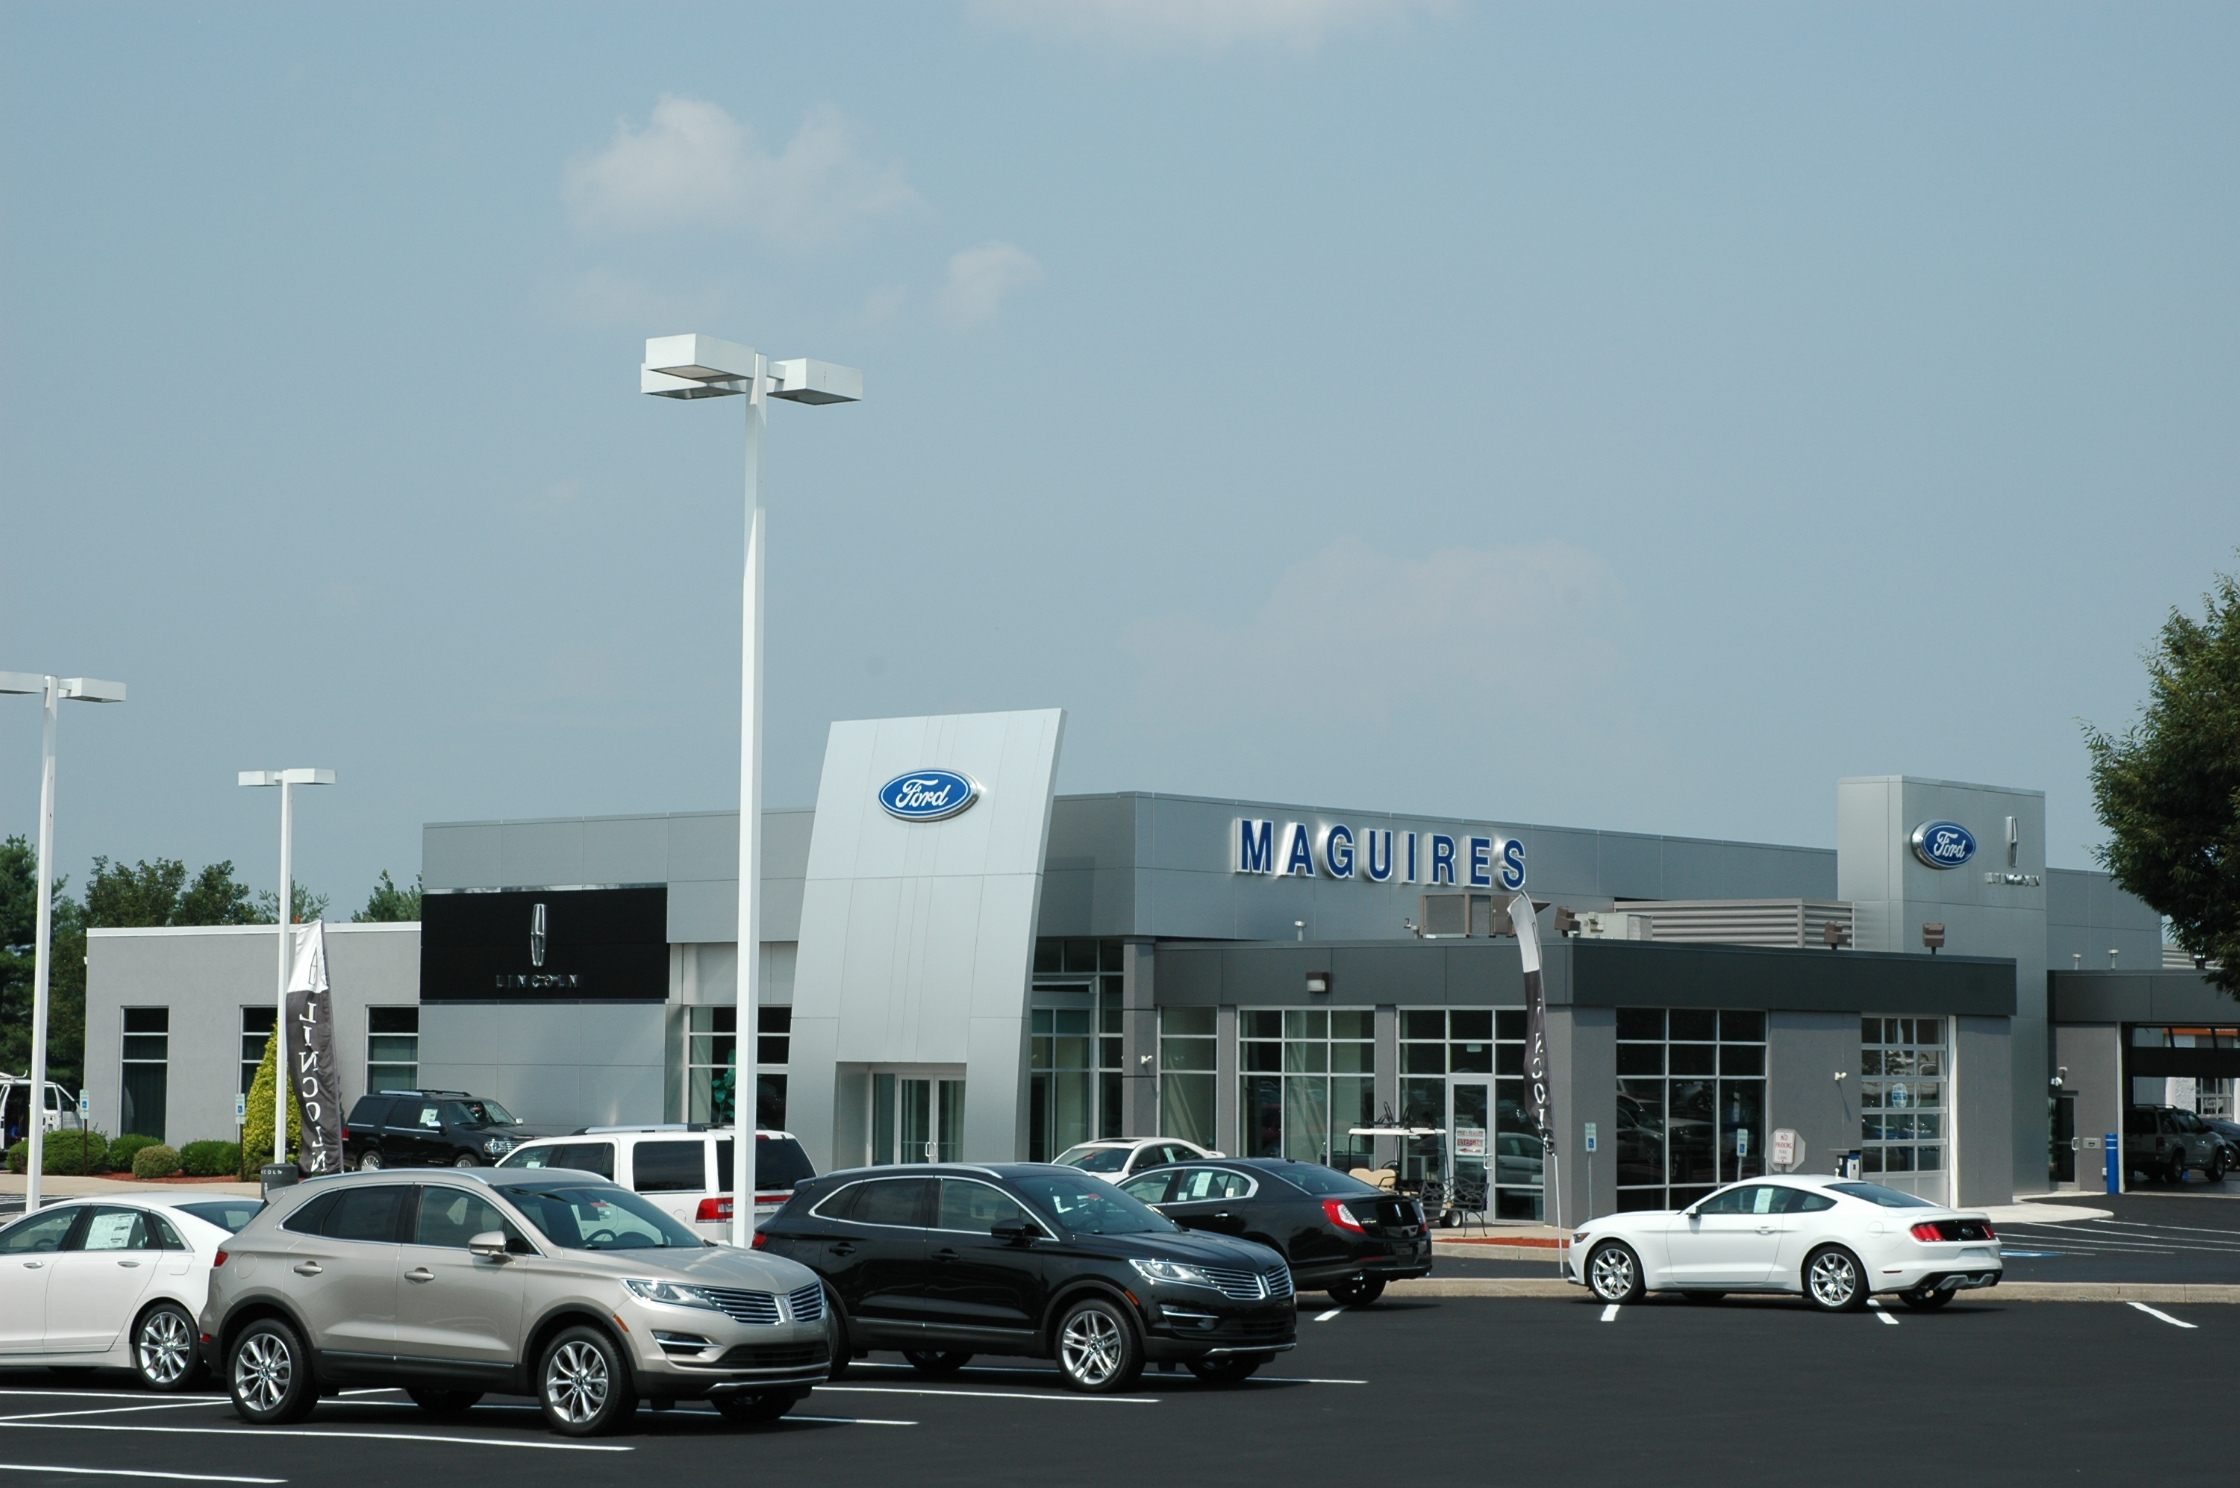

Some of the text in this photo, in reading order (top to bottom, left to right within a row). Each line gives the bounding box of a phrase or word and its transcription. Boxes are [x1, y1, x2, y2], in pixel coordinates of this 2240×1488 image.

[895, 779, 951, 808] Ford
[1235, 818, 1526, 891] MAGUIRES
[1933, 831, 1966, 859] Ford
[496, 974, 578, 988] LINCOLN
